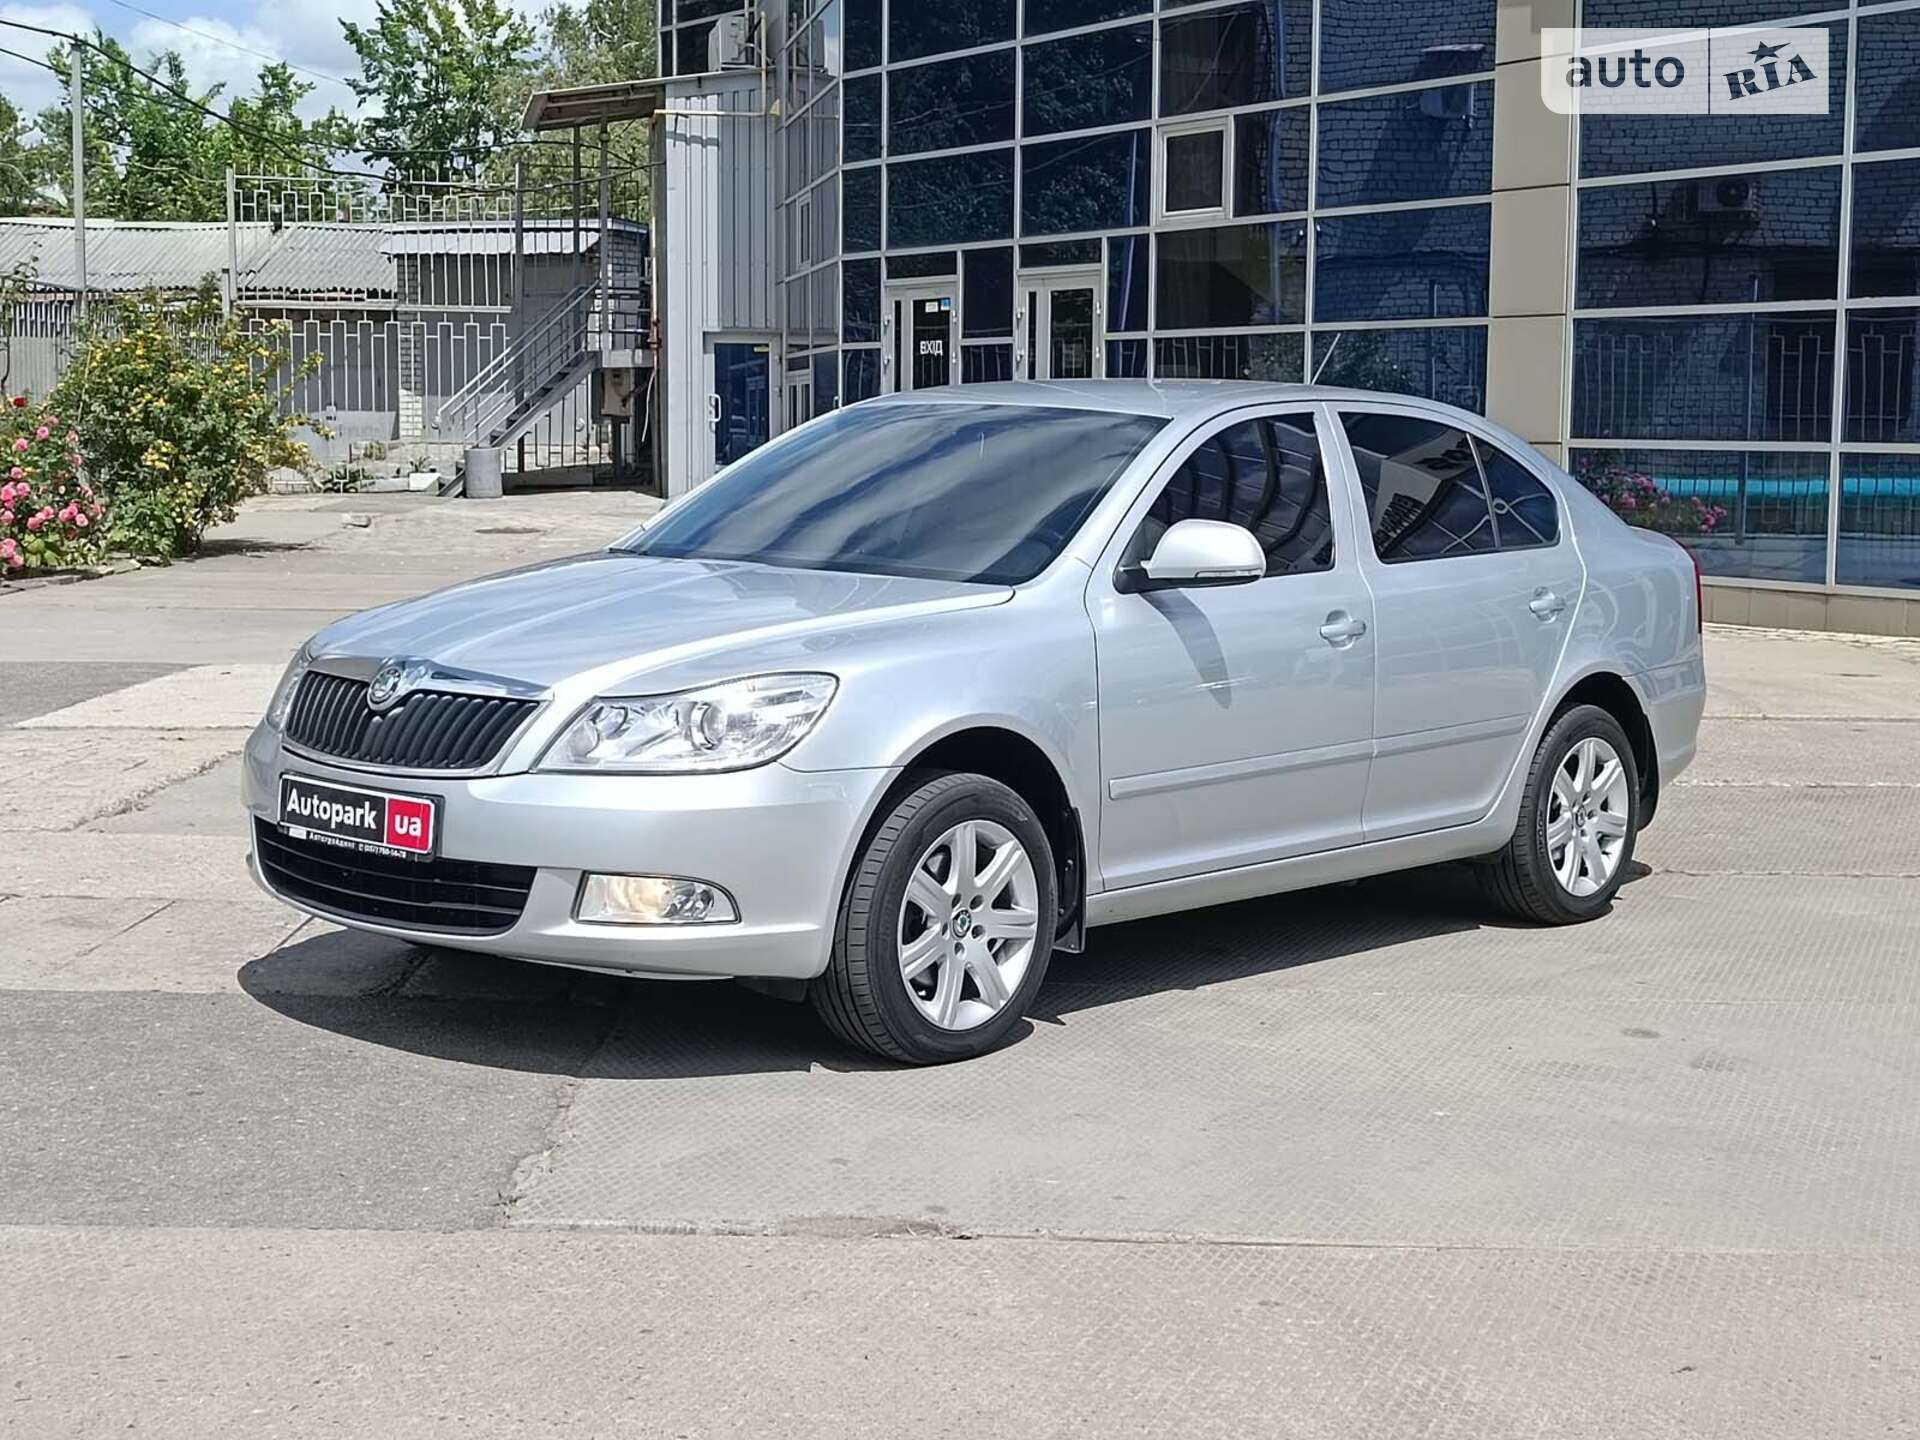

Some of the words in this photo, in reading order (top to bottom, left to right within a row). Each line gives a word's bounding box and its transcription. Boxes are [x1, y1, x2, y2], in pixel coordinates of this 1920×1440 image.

[920, 340, 943, 356] ВХІД
[287, 788, 377, 829] Autopark
[394, 814, 422, 837] ua
